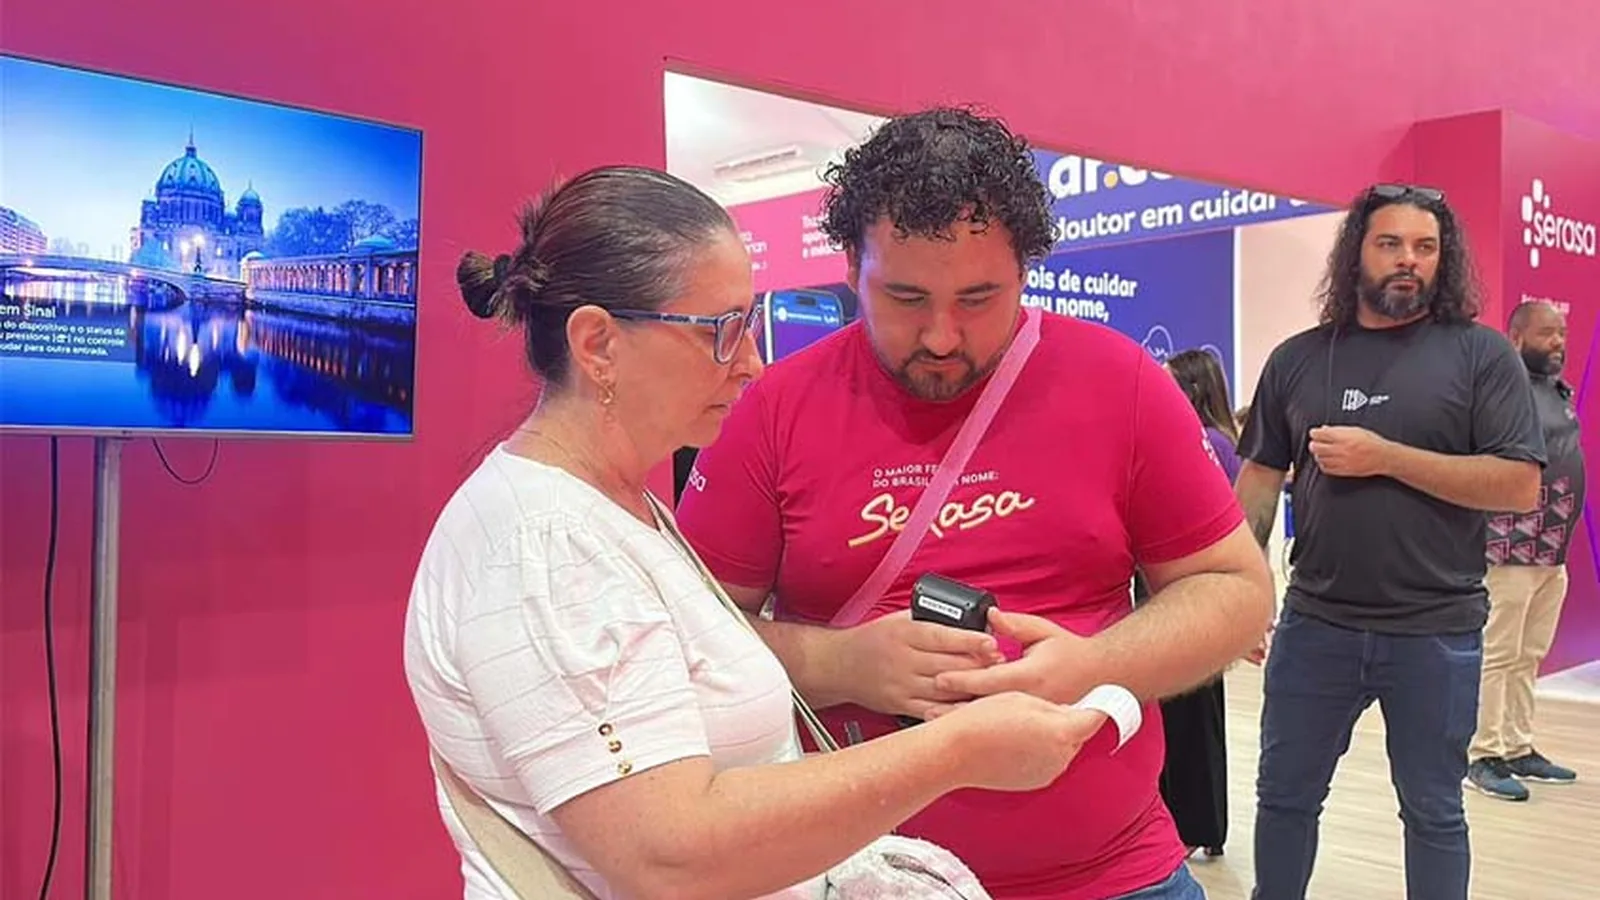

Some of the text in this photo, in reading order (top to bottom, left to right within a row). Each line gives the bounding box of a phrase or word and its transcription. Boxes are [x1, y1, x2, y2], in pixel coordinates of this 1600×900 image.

[1054, 210, 1136, 242] doutor
[1141, 203, 1183, 229] em
[1533, 211, 1596, 256] serasa
[1058, 268, 1081, 293] de
[1083, 272, 1138, 298] cuidar
[24, 303, 56, 318] Sinal
[1055, 296, 1110, 324] nome,
[872, 478, 889, 488] DO
[874, 468, 882, 478] O
[884, 464, 922, 477] MAIOR
